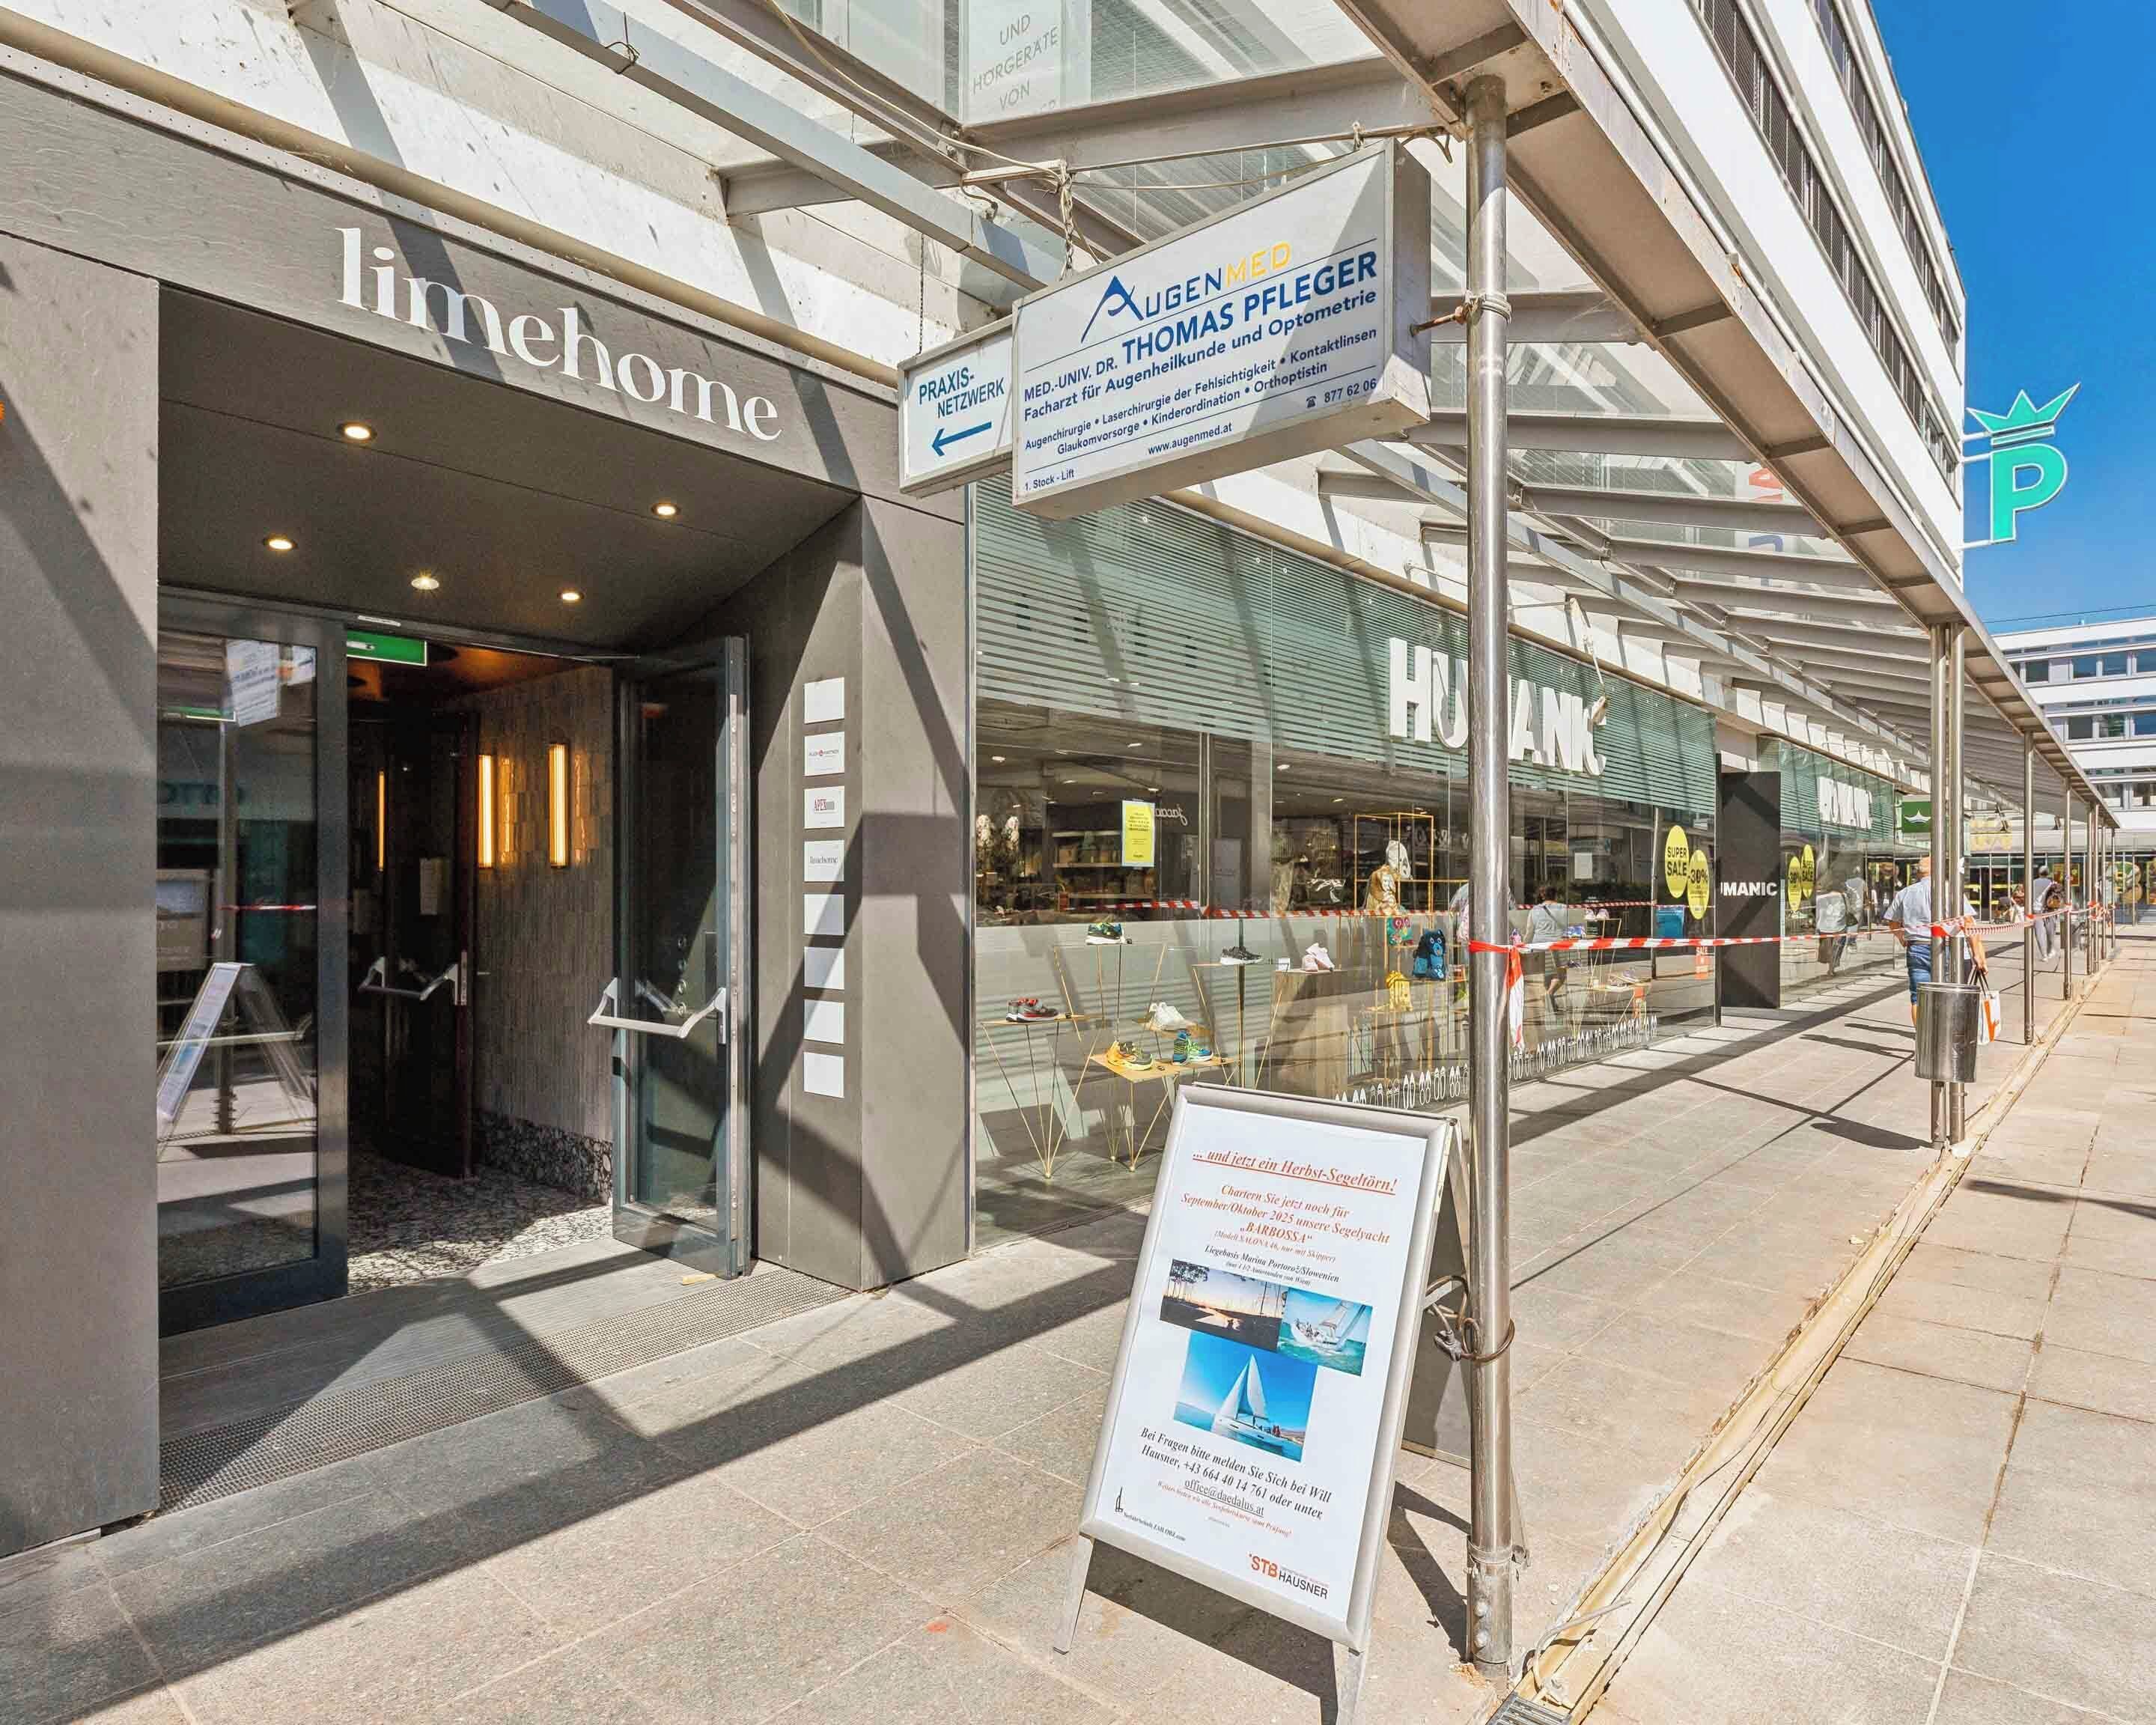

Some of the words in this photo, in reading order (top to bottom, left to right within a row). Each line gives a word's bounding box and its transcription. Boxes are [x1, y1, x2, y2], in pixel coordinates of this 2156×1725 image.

[999, 14, 1031, 46] UND
[999, 79, 1030, 111] VON
[335, 228, 782, 440] limehome
[1024, 365, 1091, 402] MED.-UNIV.
[1096, 356, 1118, 376] DR.
[1122, 302, 1234, 364] THOMAS
[1243, 251, 1377, 322] PFLEGER
[1024, 392, 1078, 422] Facharzt
[1081, 384, 1101, 402] für
[1105, 341, 1225, 393] Augenheilkunde
[1231, 324, 1262, 350] und
[1268, 289, 1377, 335] Optometrie
[919, 366, 975, 405] PRAXIS-
[937, 377, 1005, 419] NETZWERK
[1025, 419, 1091, 450] Augenchirurgie
[1102, 395, 1171, 425] Laserchirurgie
[1174, 388, 1192, 402] der
[1195, 359, 1276, 395] Fehlsichtigkeit
[1290, 329, 1377, 364] Kontaktlinsen
[1324, 388, 1343, 404] 877
[1347, 383, 1360, 397] 62
[1362, 378, 1377, 392] 06
[1057, 422, 1139, 455] Glaukomvorsorge
[1151, 389, 1240, 426] Kinderordination
[1254, 362, 1327, 393] Orthoptistin
[1148, 423, 1232, 455] www.augenmed.at
[1033, 476, 1055, 490] Stock
[1062, 469, 1074, 481] Lift
[1990, 442, 2068, 544] P
[1389, 636, 1607, 776] HUANIC
[1667, 847, 1687, 860] SUPER
[1667, 862, 1687, 877] SALE
[1720, 881, 1778, 897] MANIC
[1207, 1151, 1231, 1163] und
[1231, 1151, 1256, 1168] jetzt
[1258, 1157, 1278, 1171] ein
[1282, 1160, 1398, 1192] Herbst-Segeltörn!
[1181, 1193, 1268, 1219] September/Oktober
[1269, 1210, 1294, 1224] 2025
[1295, 1217, 1330, 1232] unsere
[1332, 1223, 1390, 1244] Segelyacht
[1221, 1184, 1262, 1202] Chartern
[1264, 1192, 1280, 1205] Sie
[1282, 1194, 1303, 1210] jetzt
[1304, 1203, 1330, 1214] noch
[1204, 1245, 1240, 1260] Liegebasis
[1241, 1253, 1266, 1266] Marina
[1141, 1427, 1157, 1441] Bei
[1157, 1433, 1189, 1453] Fragen
[1190, 1445, 1211, 1461] bitte
[1213, 1457, 1246, 1473] melden
[1247, 1465, 1264, 1480] Sie
[1265, 1471, 1288, 1488] Sich
[1290, 1479, 1308, 1494] bei
[1309, 1485, 1332, 1503] Will
[1142, 1444, 1181, 1468] Hausner,
[1183, 1461, 1201, 1474] +43
[1202, 1467, 1220, 1482] 664
[1222, 1473, 1234, 1486] 40
[1236, 1479, 1248, 1492] 14
[1251, 1483, 1267, 1498] 761
[1269, 1494, 1293, 1508] oder
[1294, 1502, 1323, 1520] unter
[1184, 1479, 1264, 1516] office@daedalus.at
[1278, 1570, 1329, 1600] HAUSNER
